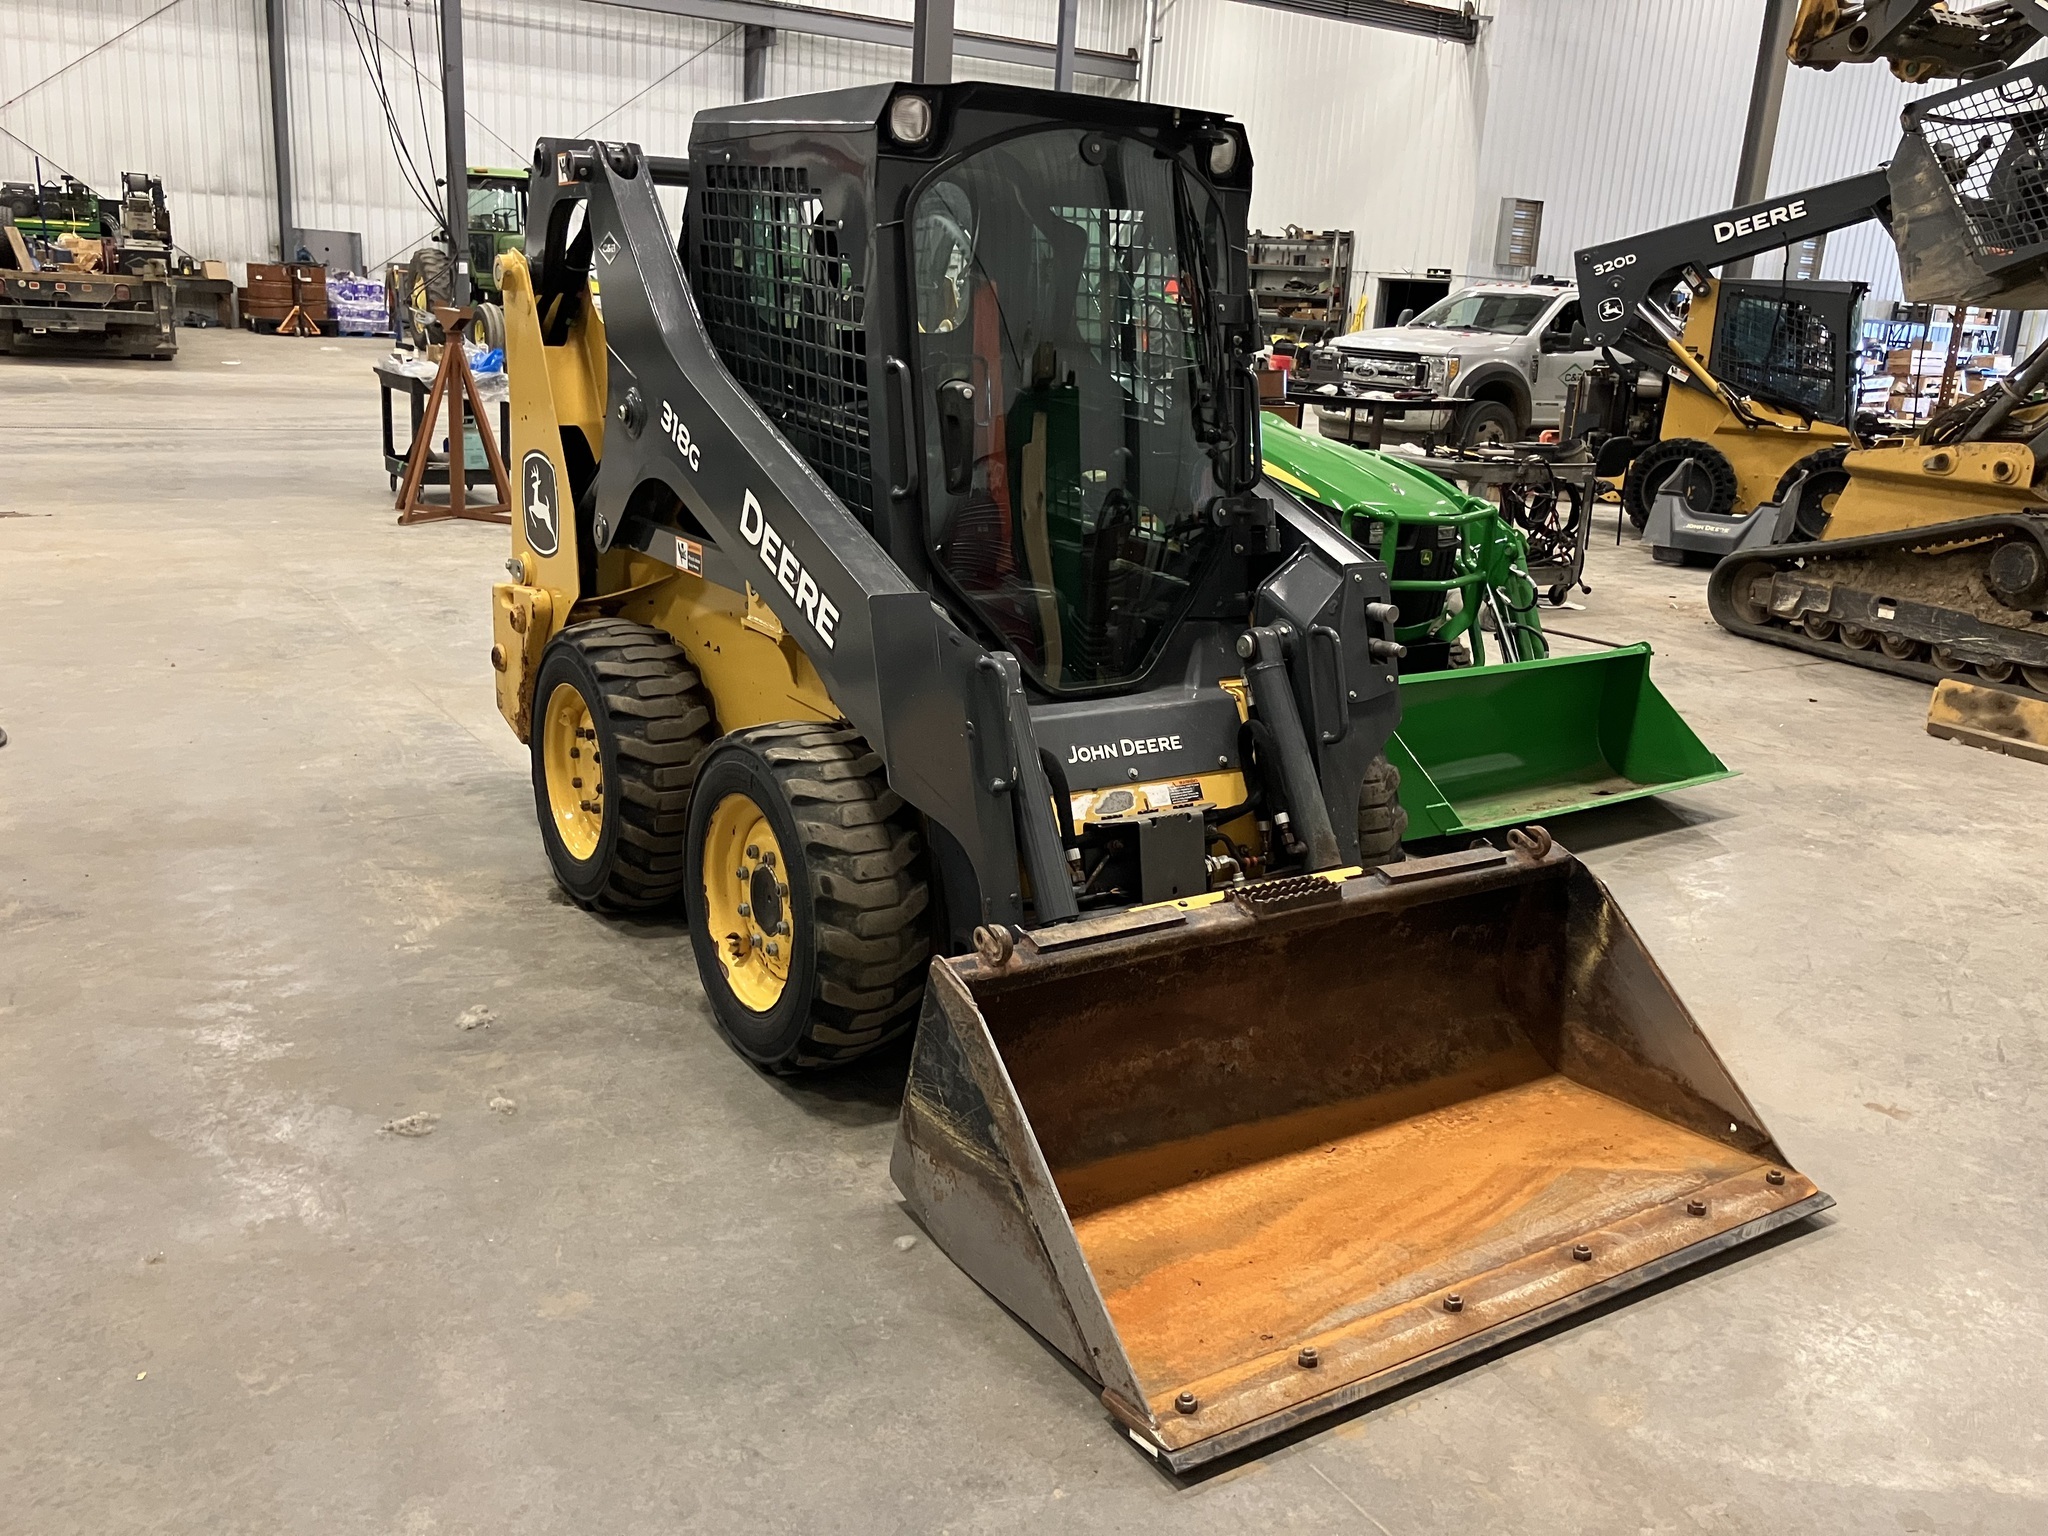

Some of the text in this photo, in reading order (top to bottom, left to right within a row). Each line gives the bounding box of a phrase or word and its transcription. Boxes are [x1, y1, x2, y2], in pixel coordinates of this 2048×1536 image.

[1713, 200, 1808, 244] DEERE
[1593, 254, 1637, 276] 320D
[660, 399, 701, 473] 318G
[739, 487, 840, 650] DEERE
[1067, 735, 1183, 764] JOHN DEERE
